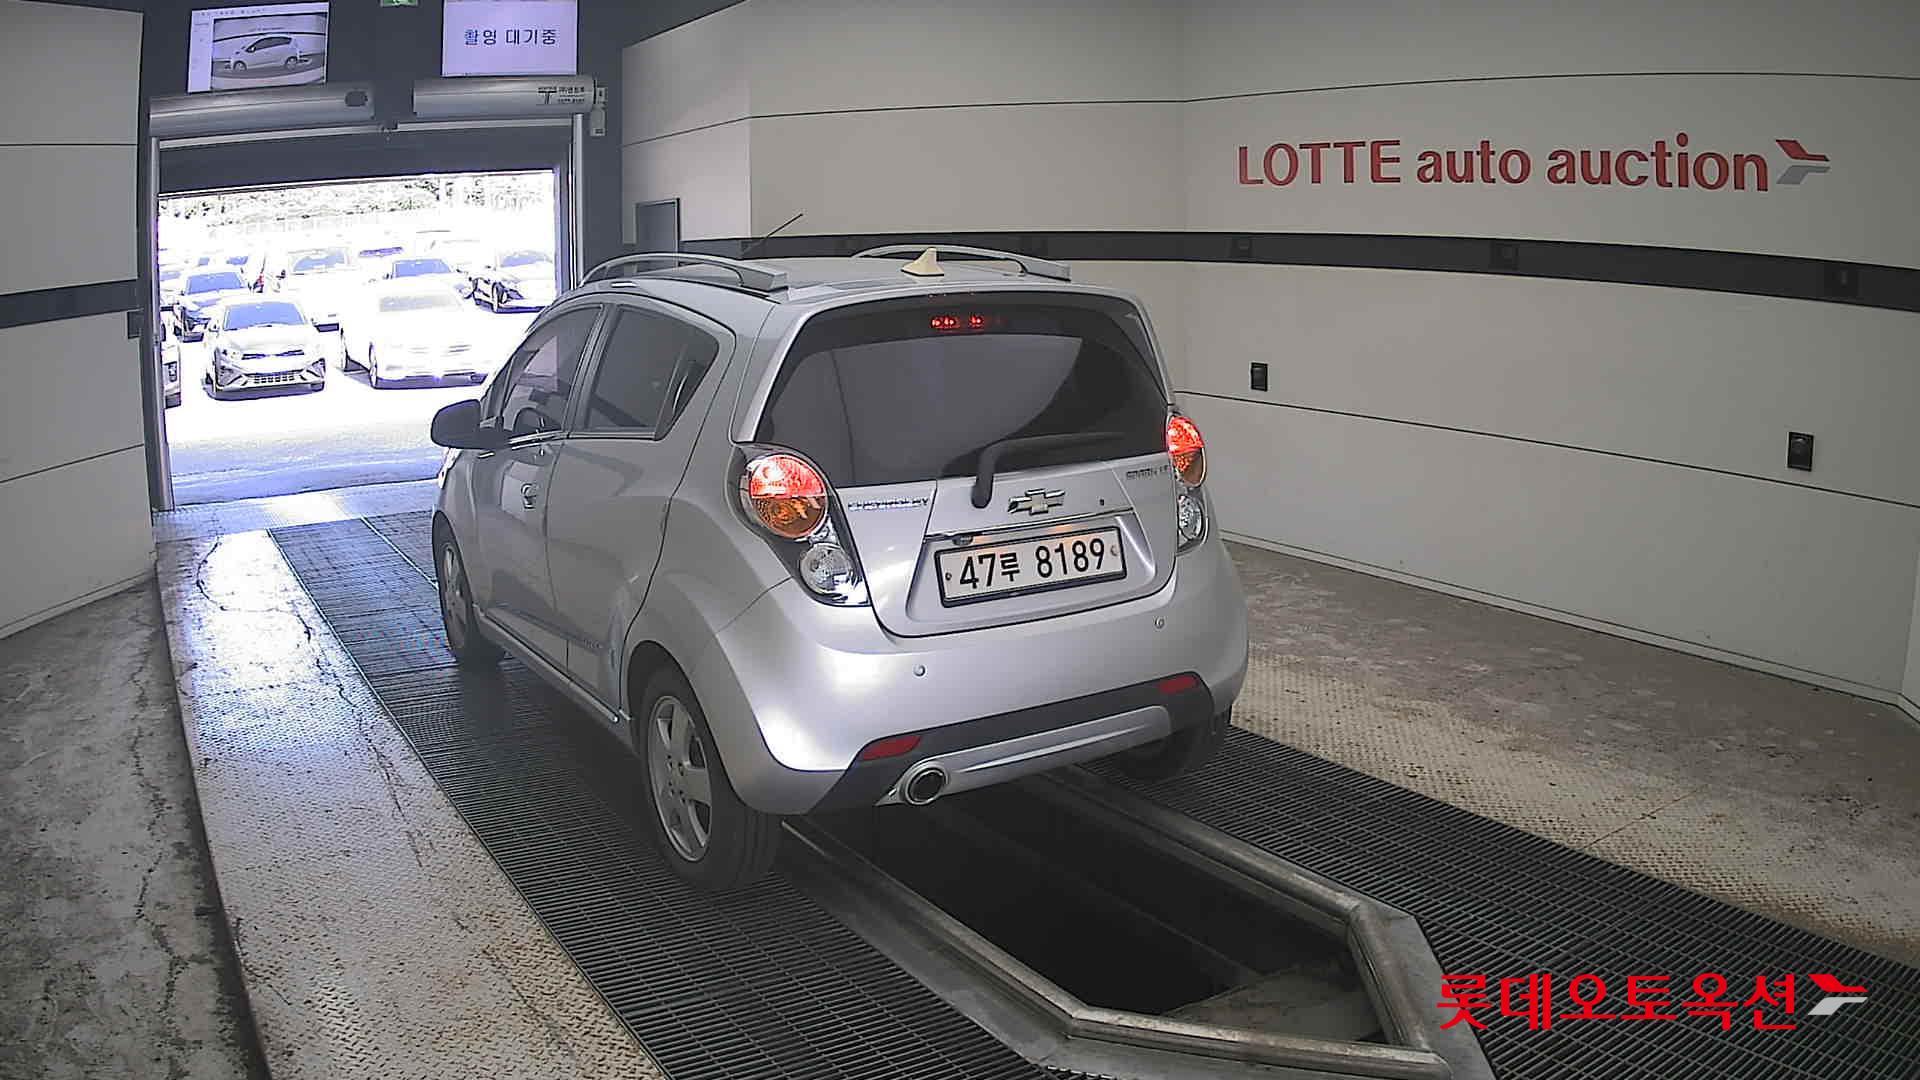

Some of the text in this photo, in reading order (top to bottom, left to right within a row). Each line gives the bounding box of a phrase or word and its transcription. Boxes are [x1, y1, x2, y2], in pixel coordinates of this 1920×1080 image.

[505, 29, 557, 46] 대기중
[1239, 133, 1769, 191] LOTTE auto auction
[959, 538, 1105, 589] 47루 8189
